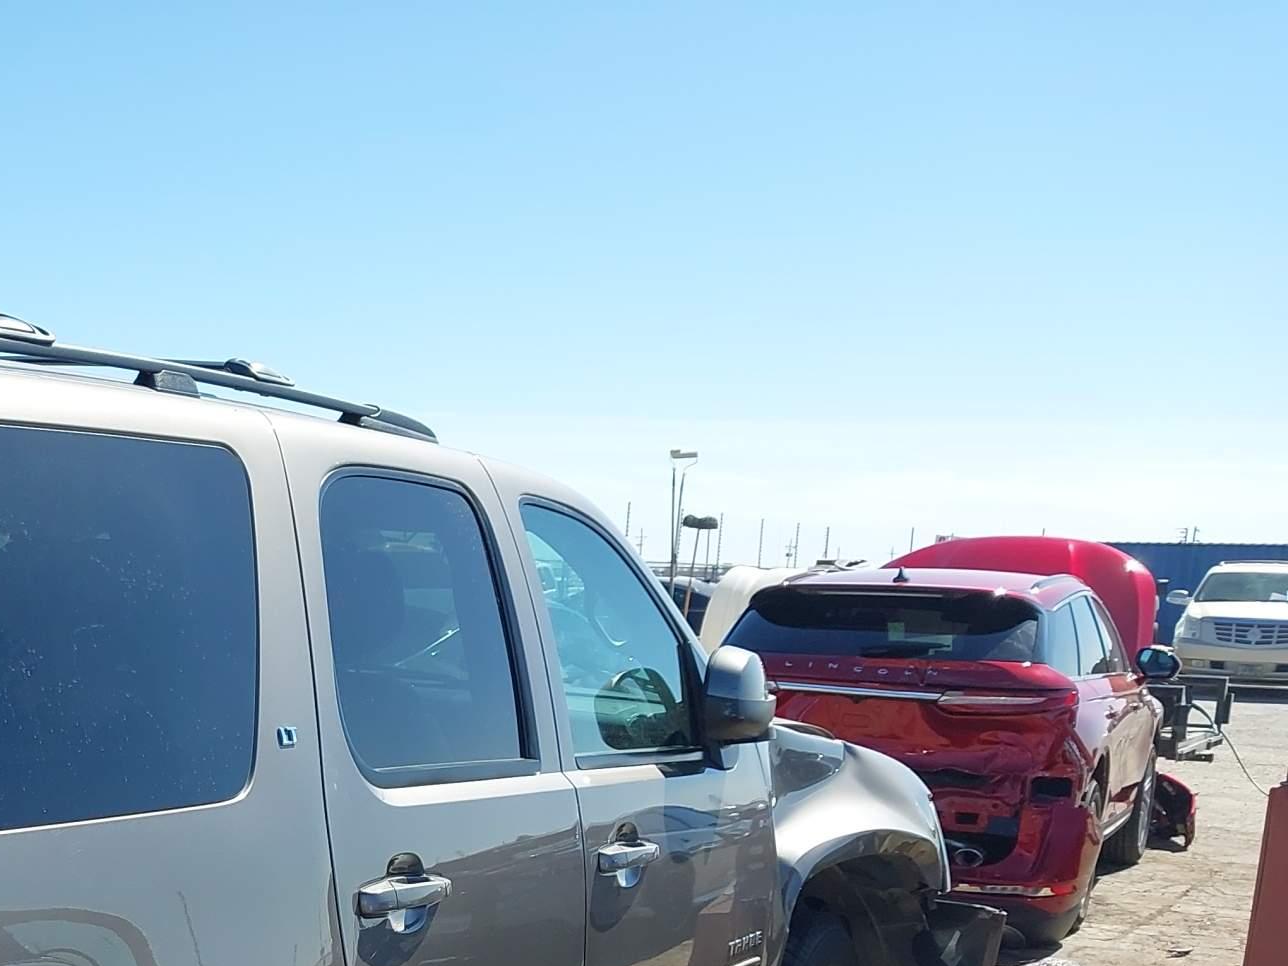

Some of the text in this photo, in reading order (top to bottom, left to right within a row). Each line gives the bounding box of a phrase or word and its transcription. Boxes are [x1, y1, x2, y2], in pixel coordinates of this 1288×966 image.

[784, 659, 939, 677] LINCOLN
[277, 726, 297, 749] LT
[728, 930, 762, 956] TAHOE
